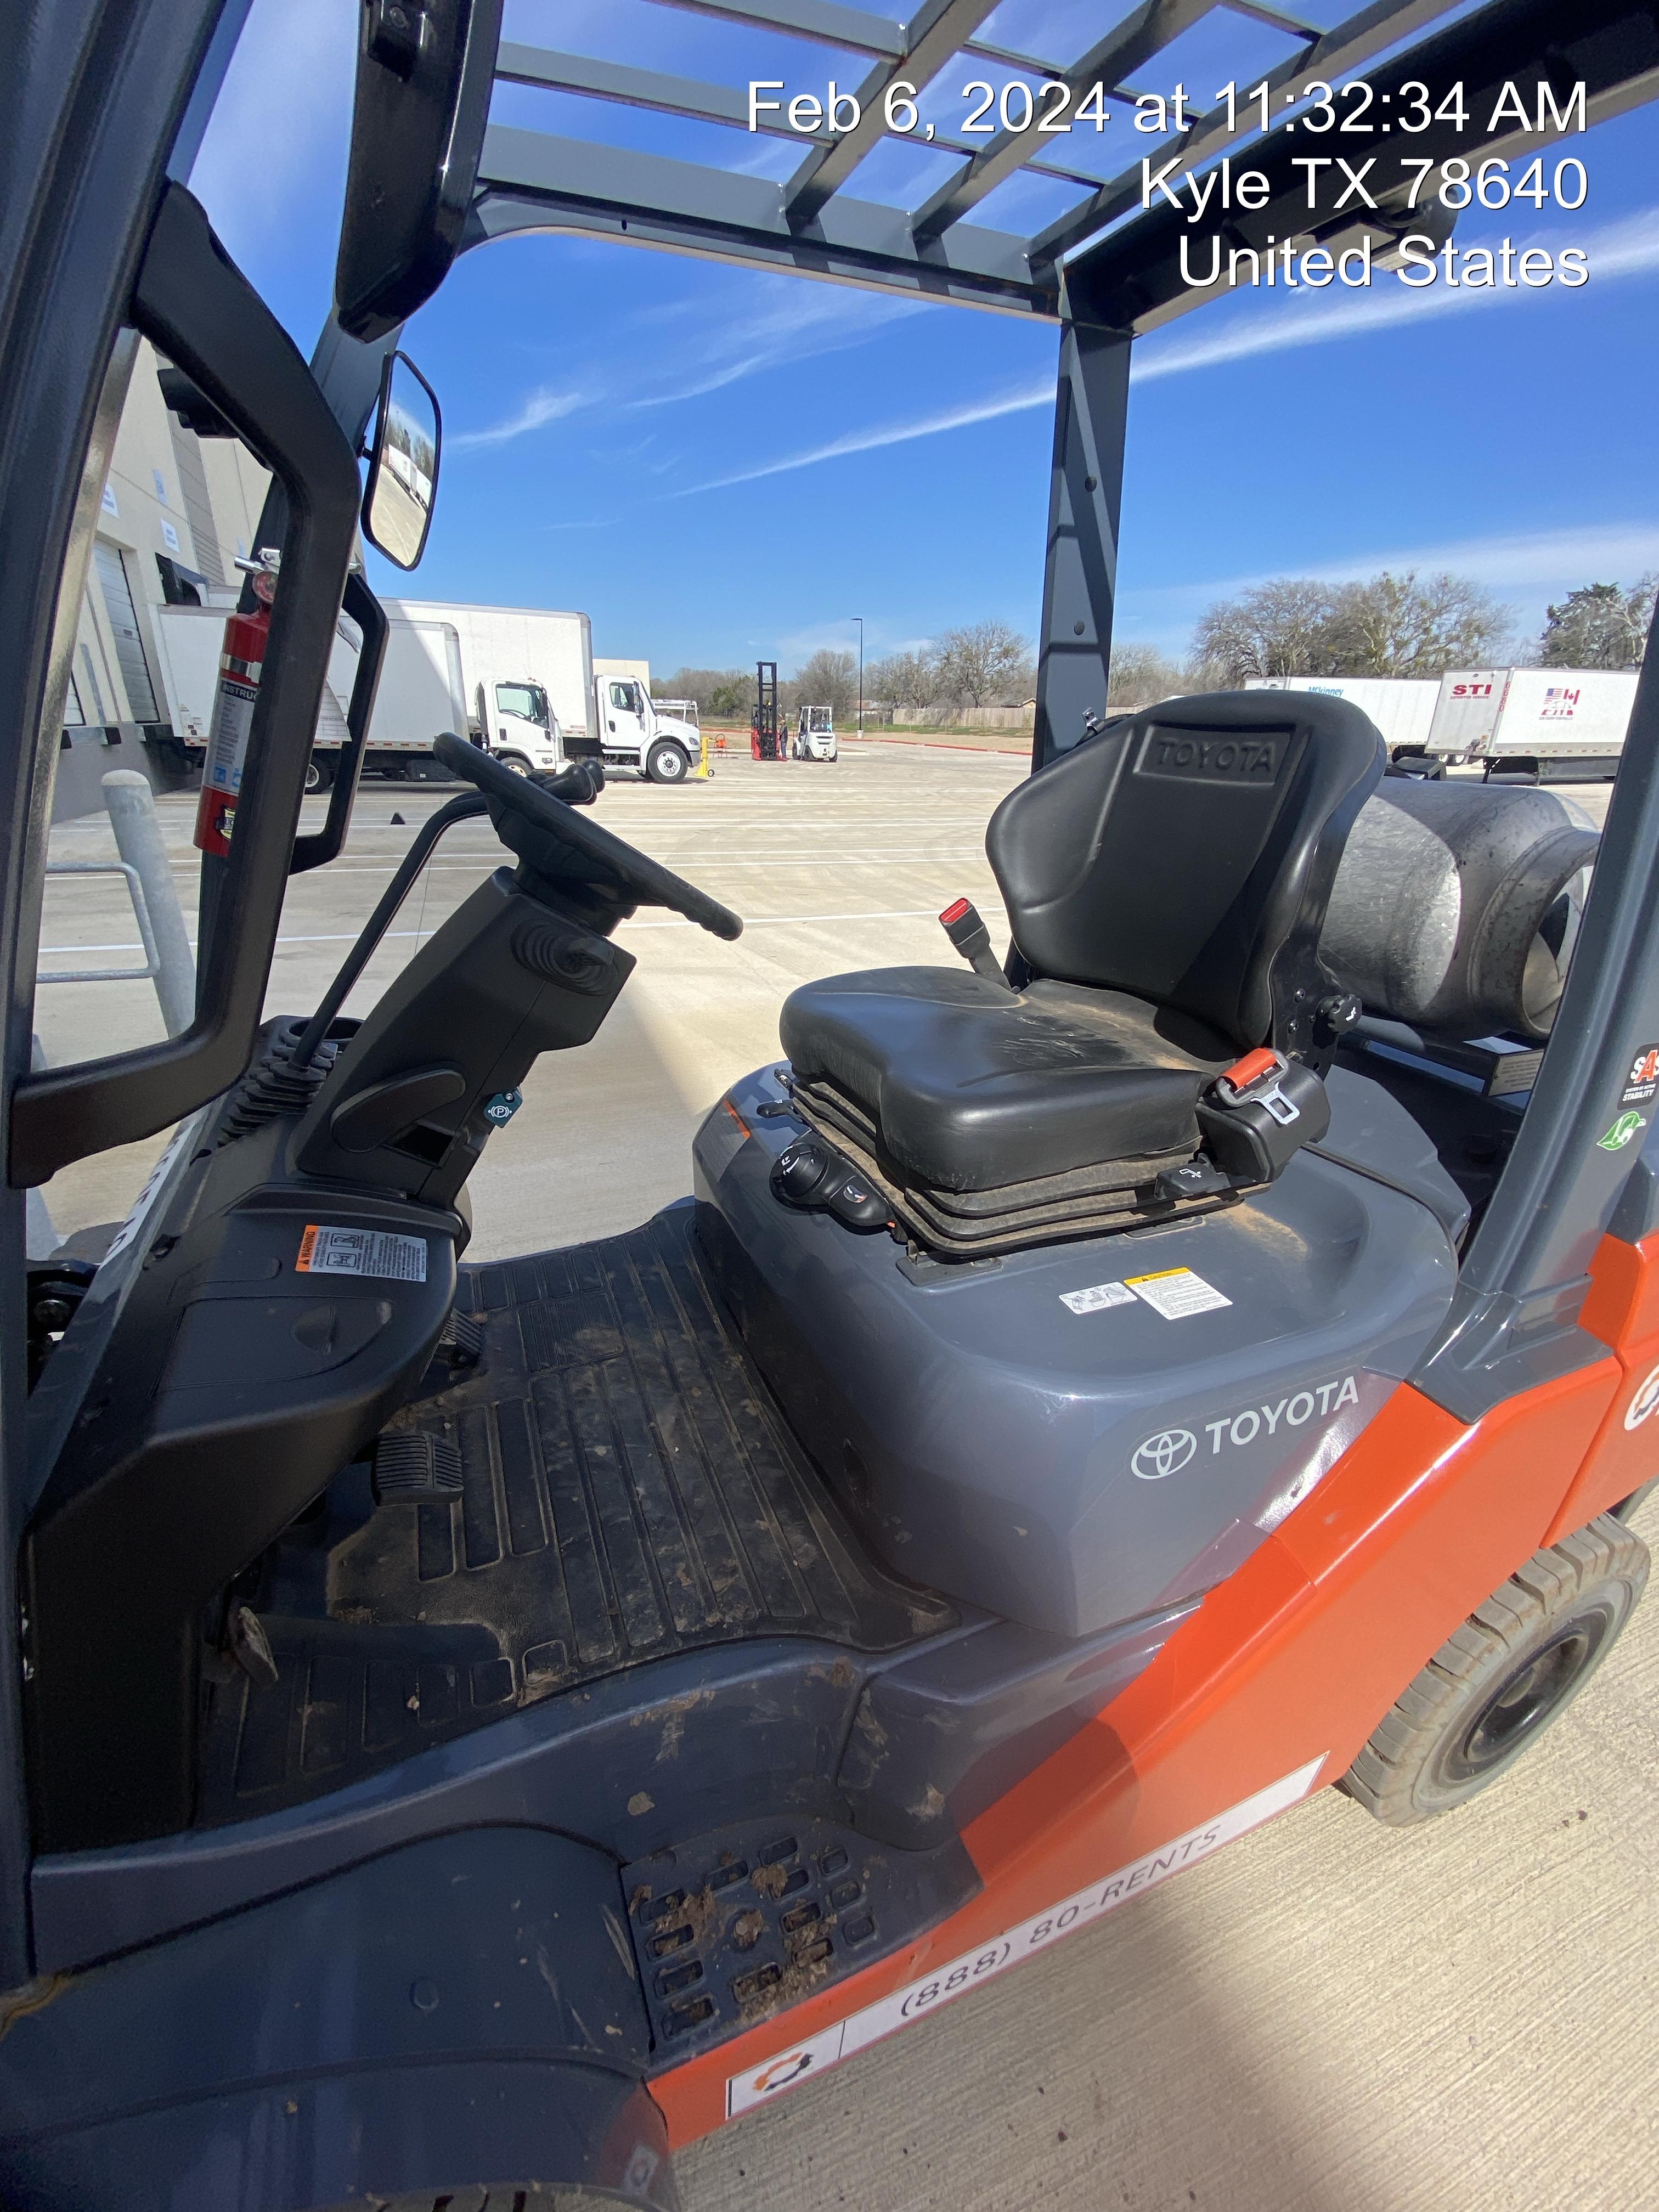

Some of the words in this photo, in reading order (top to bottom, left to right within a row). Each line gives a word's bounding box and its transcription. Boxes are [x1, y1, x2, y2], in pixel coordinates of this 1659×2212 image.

[1453, 684, 1492, 695] STI
[1157, 738, 1276, 772] TOYOTA
[1622, 1088, 1655, 1102] STABILITY
[301, 1231, 315, 1258] WARNING
[1205, 1375, 1359, 1454] TOYOTA
[900, 1943, 1011, 2017] (888)
[1029, 1825, 1222, 1944] 80-RENTS
